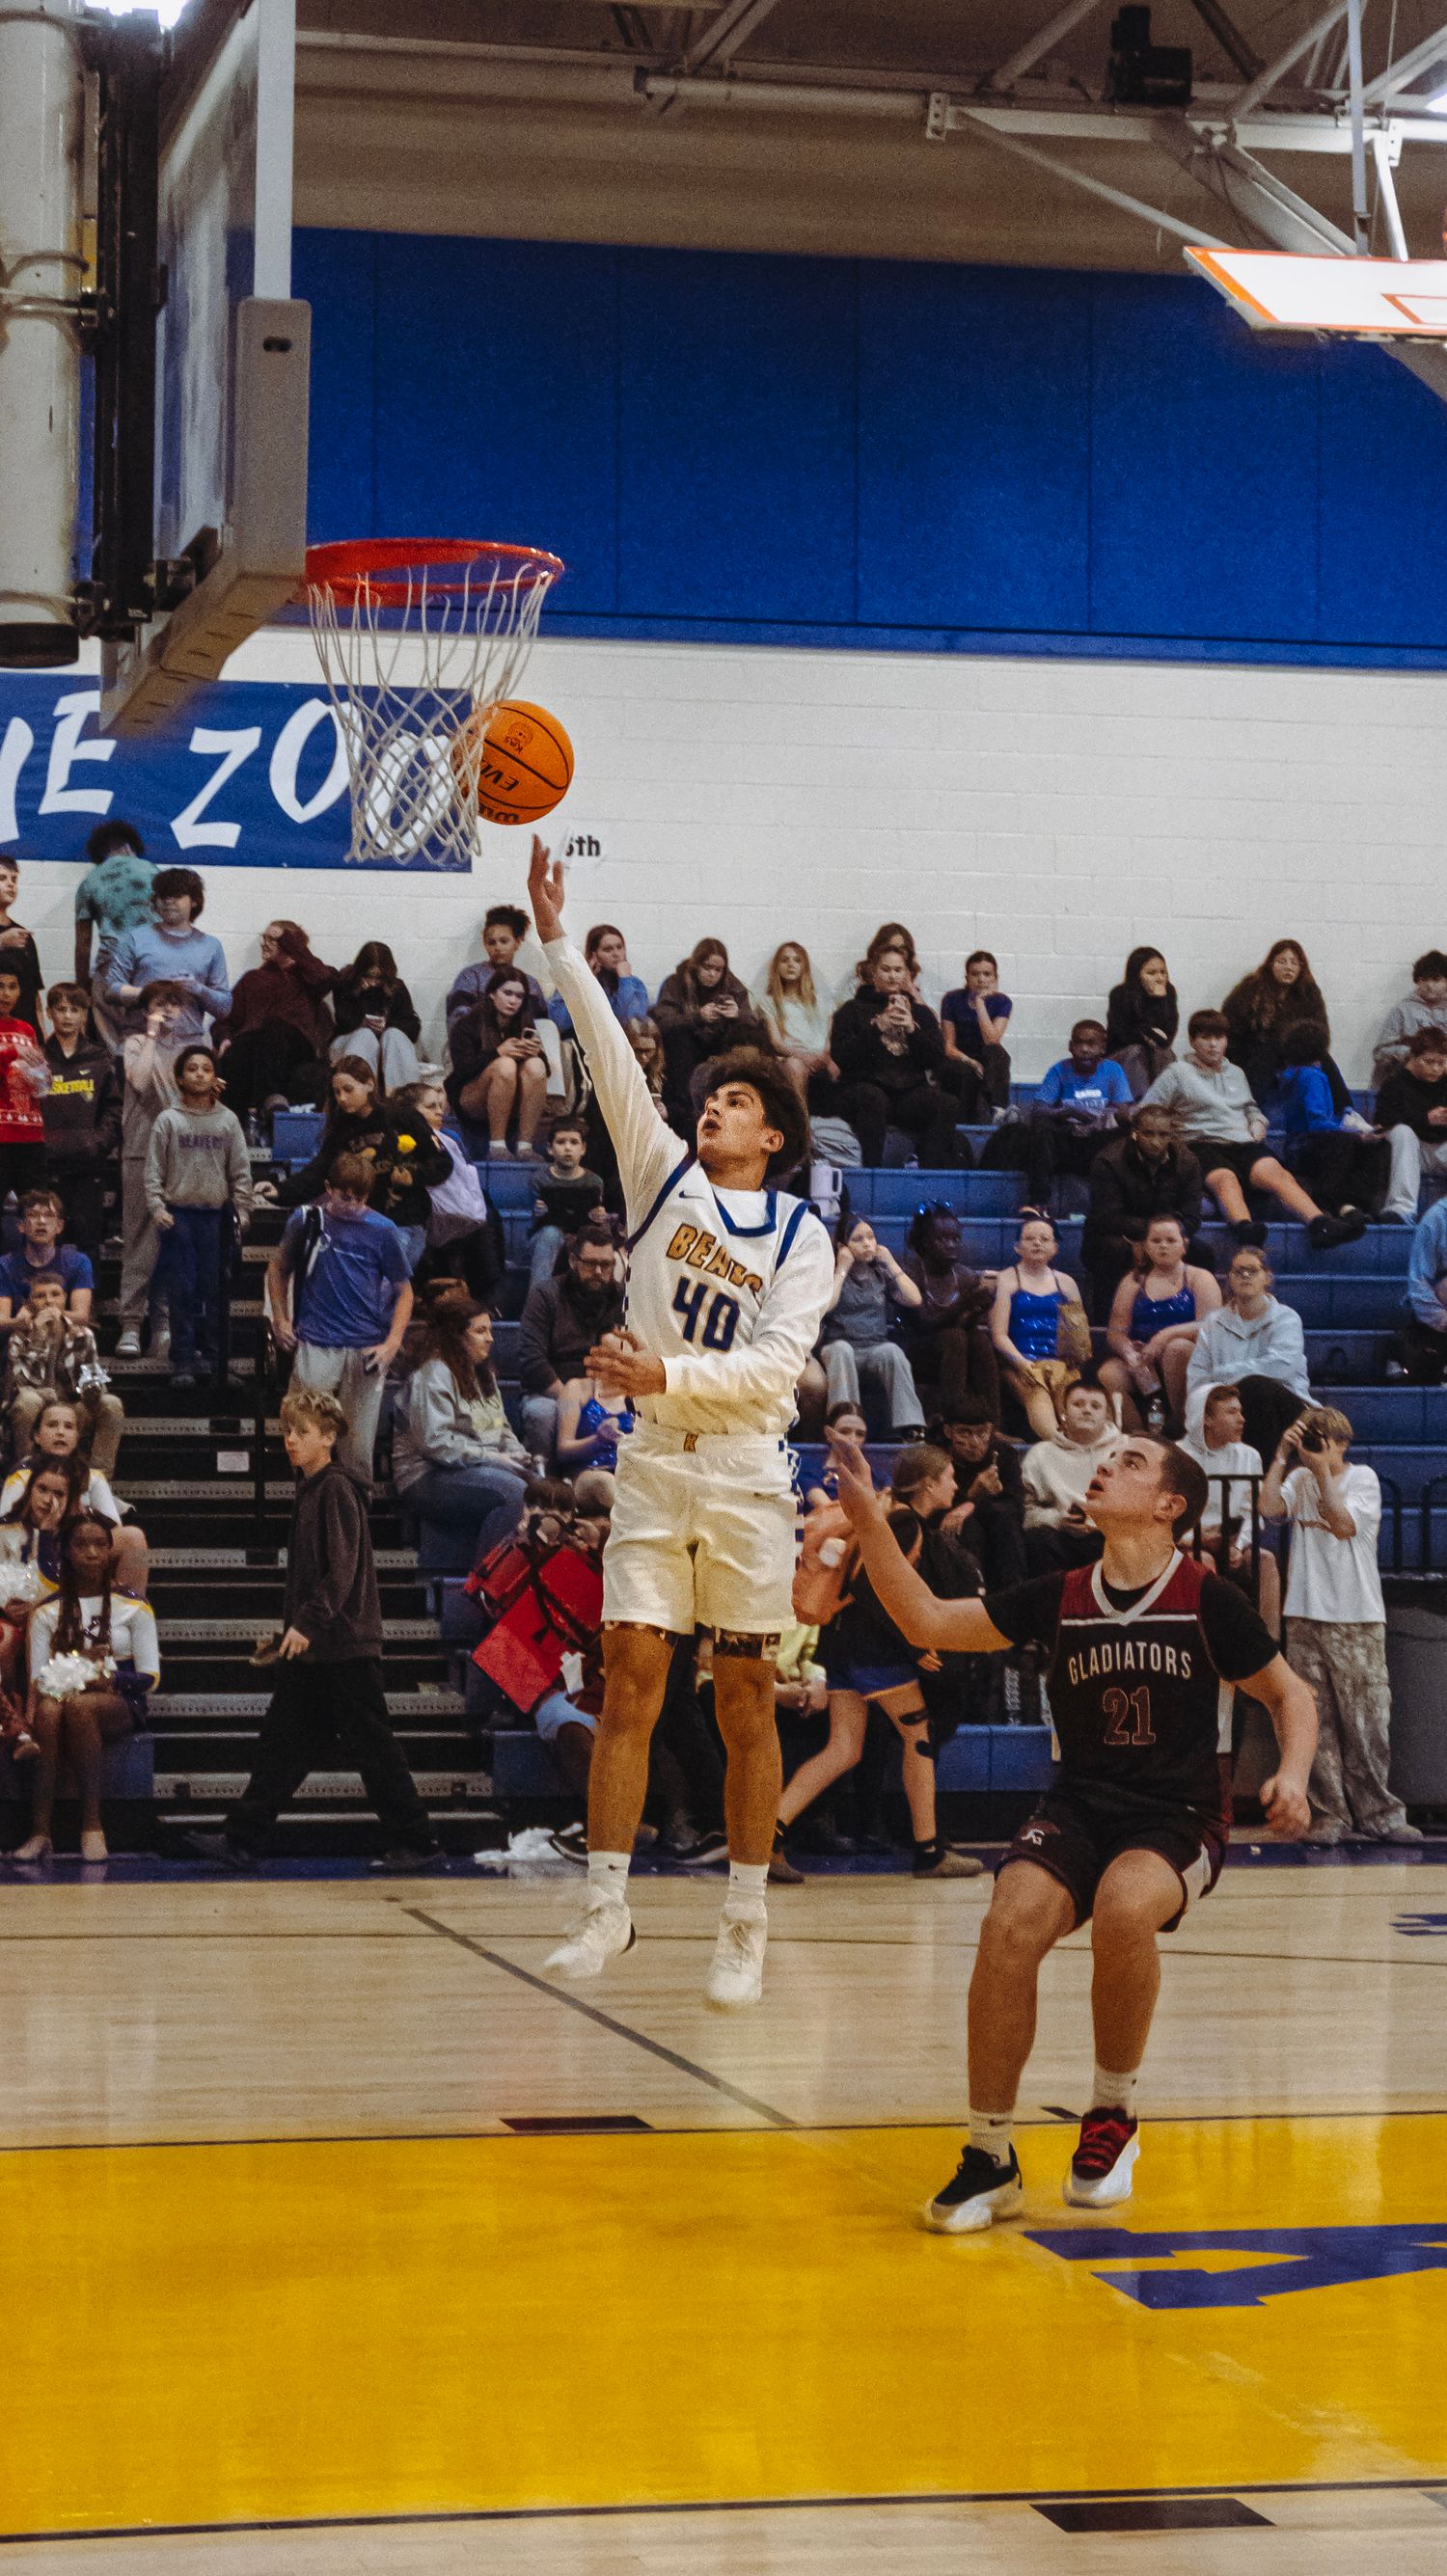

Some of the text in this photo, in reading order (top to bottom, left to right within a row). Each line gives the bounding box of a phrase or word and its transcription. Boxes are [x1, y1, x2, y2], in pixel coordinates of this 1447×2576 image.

[673, 1276, 741, 1352] 40
[1067, 1641, 1192, 1687] GLADIATORS
[1102, 1686, 1157, 1746] 21
